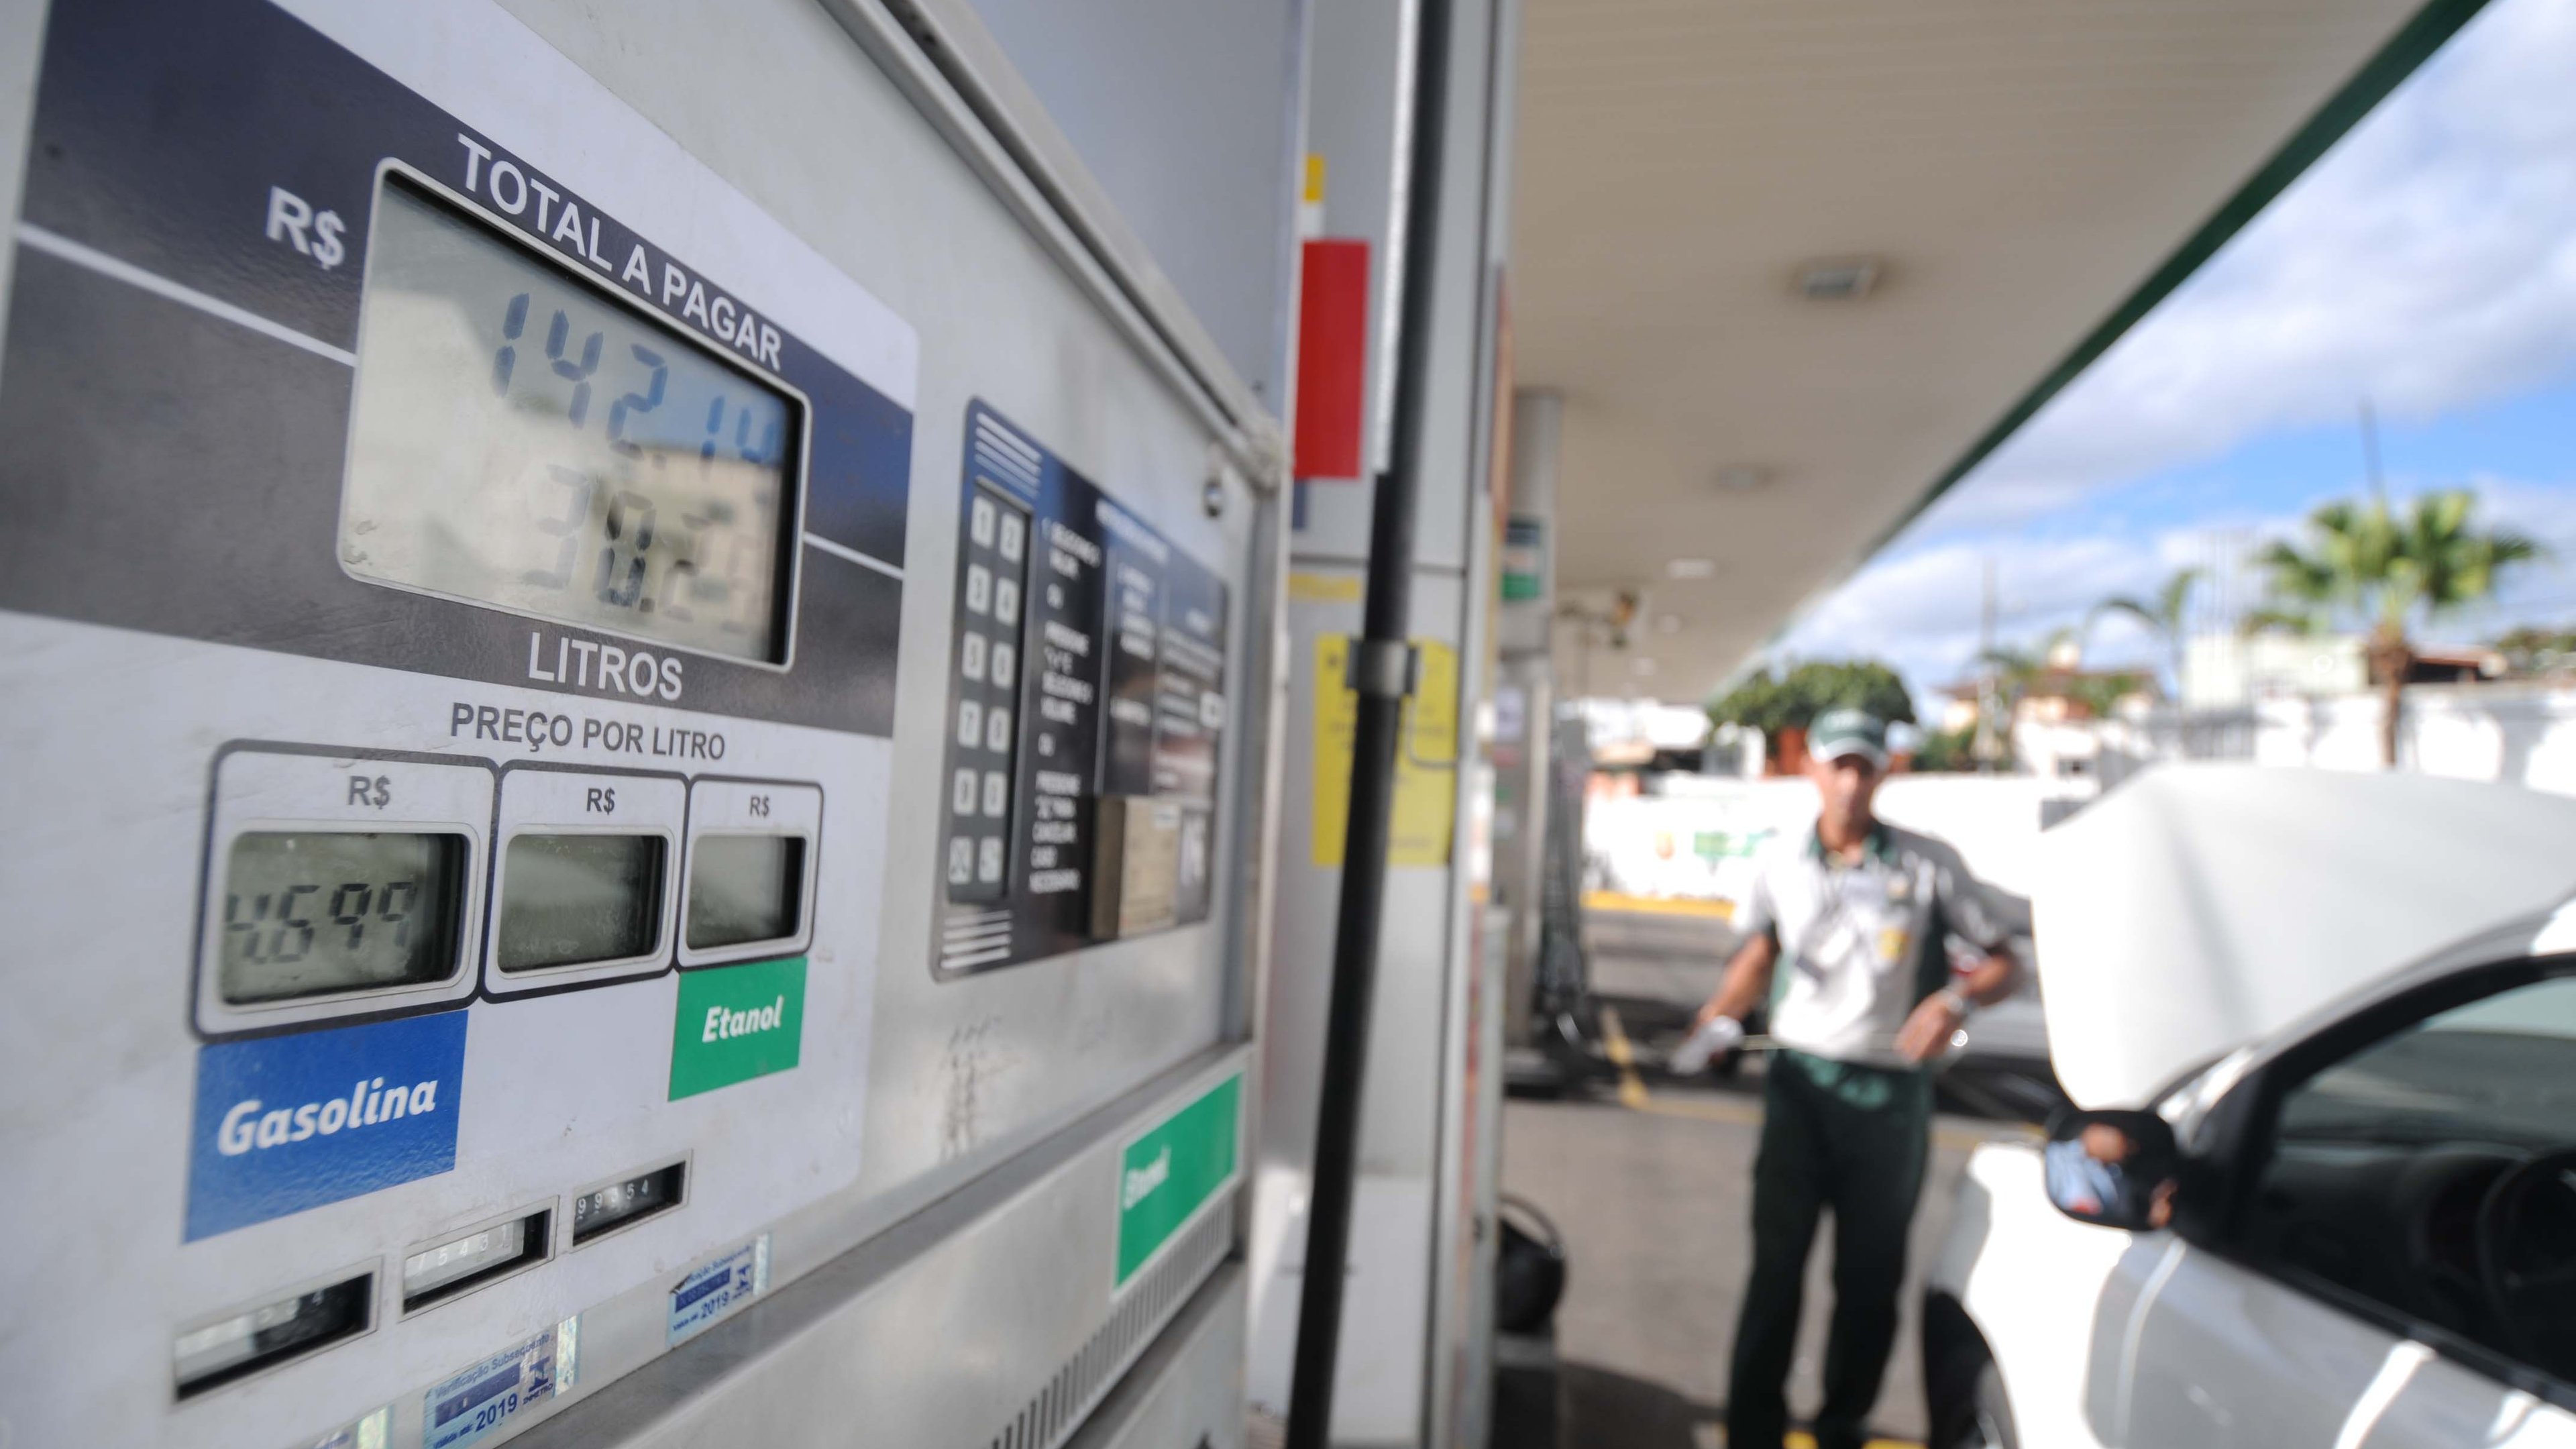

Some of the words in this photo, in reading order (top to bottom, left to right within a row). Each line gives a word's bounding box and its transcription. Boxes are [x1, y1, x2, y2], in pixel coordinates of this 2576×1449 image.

[266, 186, 346, 270] R$
[458, 133, 613, 272] TOTAL
[623, 244, 652, 295] A
[663, 262, 783, 371] PAGAR
[528, 632, 683, 701] LITROS
[451, 702, 573, 752] PREÇO
[582, 718, 645, 754] POR
[652, 727, 726, 761] LITRO
[348, 775, 391, 809] R$
[586, 787, 616, 815] R$
[749, 795, 771, 818] R$
[702, 995, 785, 1043] Etanol
[217, 1076, 439, 1157] Gasolina
[701, 1291, 731, 1320] 2019
[475, 1393, 518, 1433] 2019
